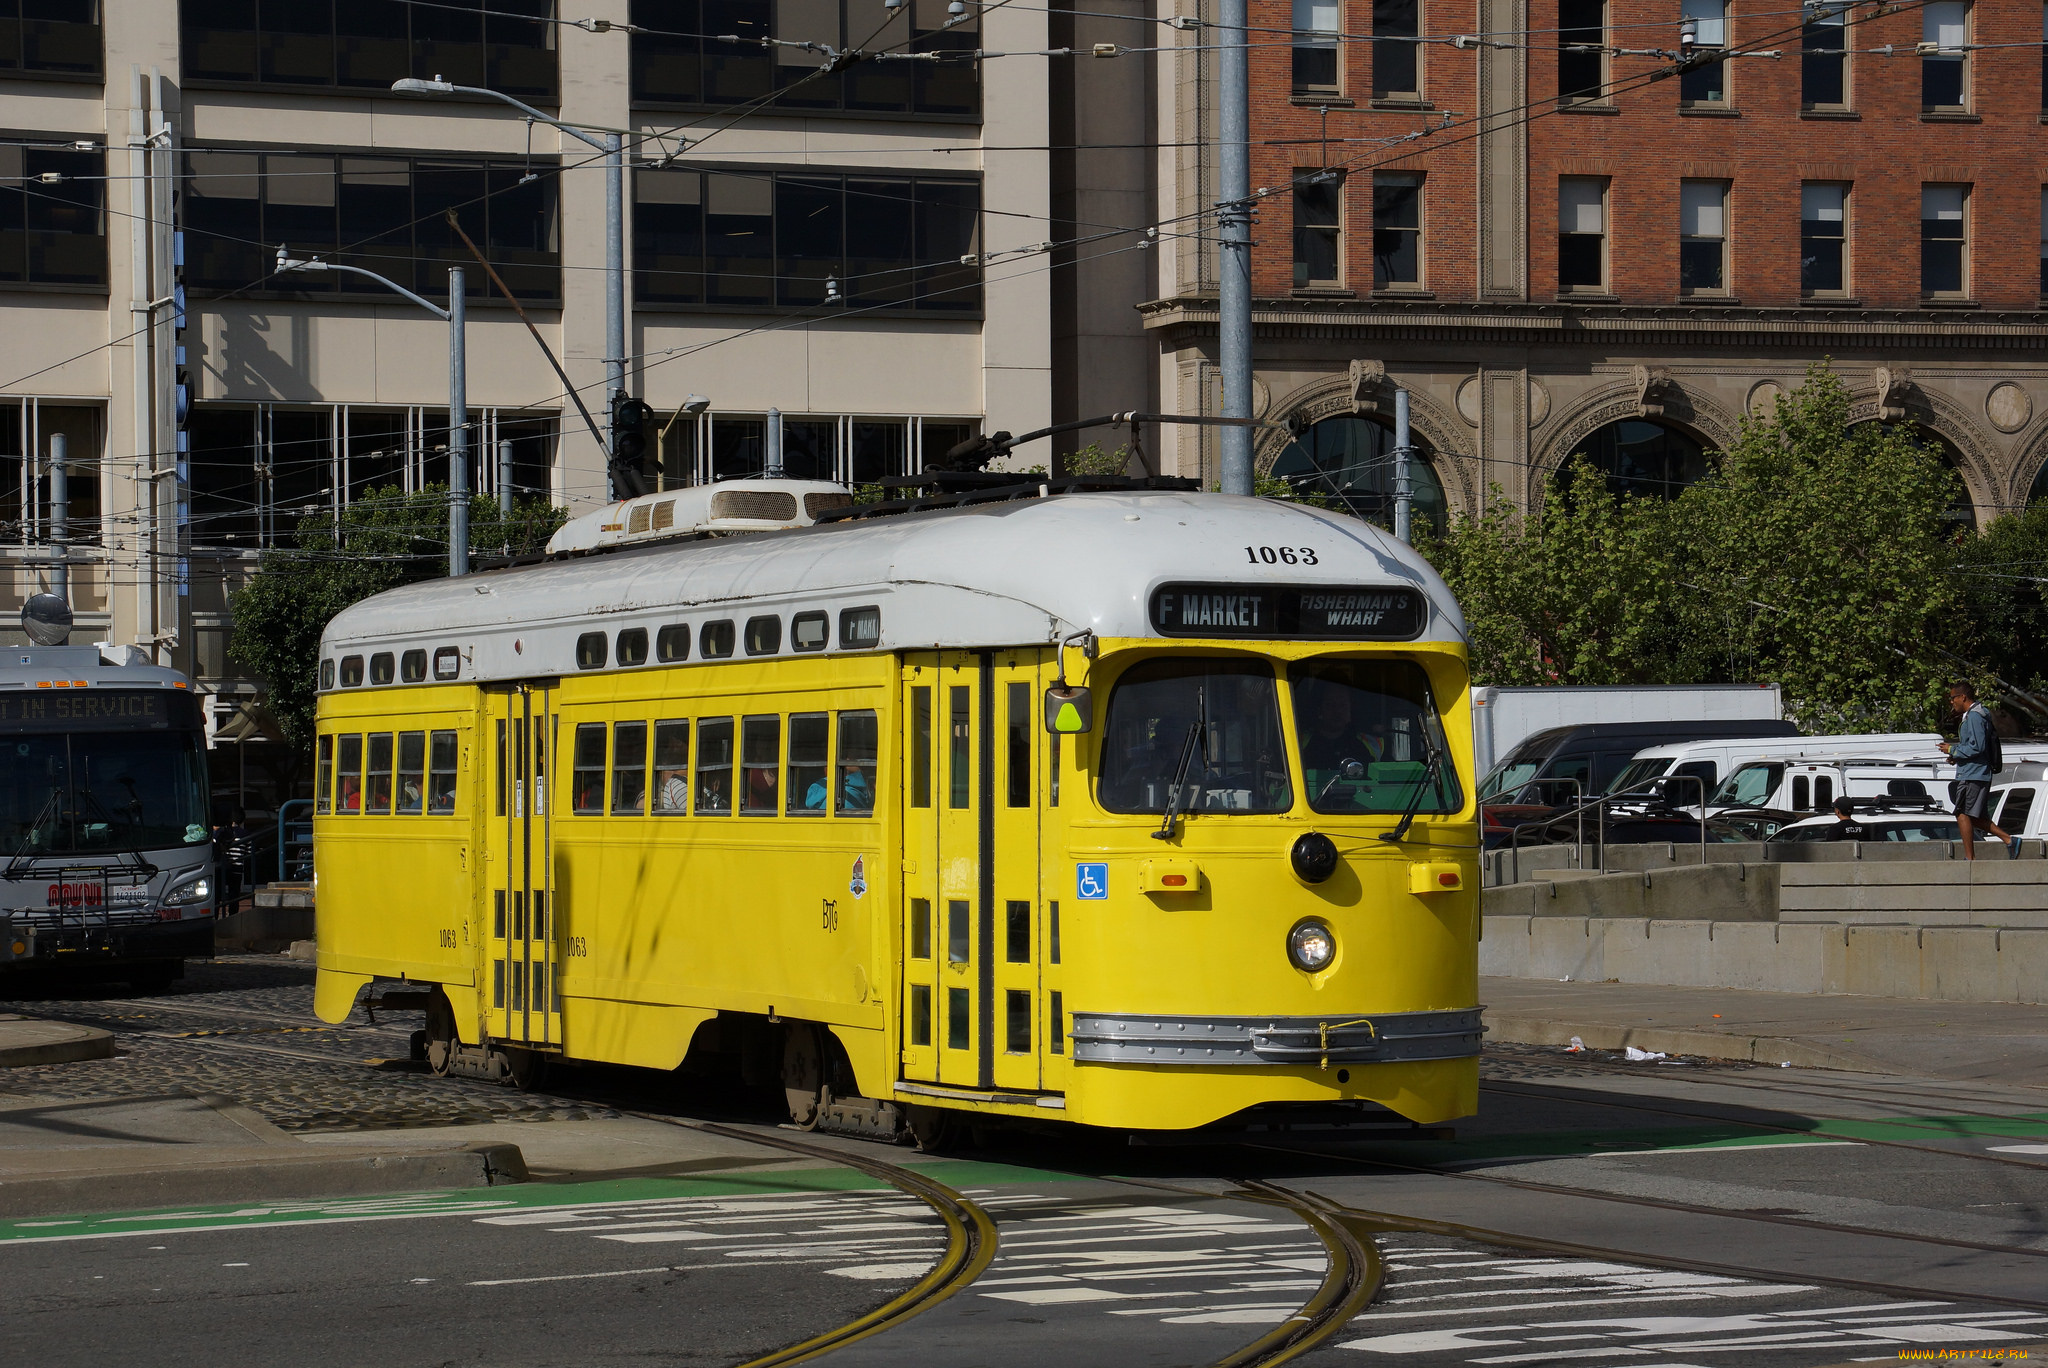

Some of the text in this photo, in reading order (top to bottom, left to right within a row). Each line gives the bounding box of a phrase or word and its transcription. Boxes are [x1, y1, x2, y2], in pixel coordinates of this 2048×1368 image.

[1244, 546, 1319, 565] 1063
[1159, 594, 1261, 627] F MARKET
[1300, 595, 1408, 610] FISHERMAN'S
[1327, 611, 1384, 626] WHARF
[21, 698, 45, 719] IN
[56, 695, 155, 718] SERVICE
[439, 928, 457, 949] 1063
[566, 936, 587, 957] 1063
